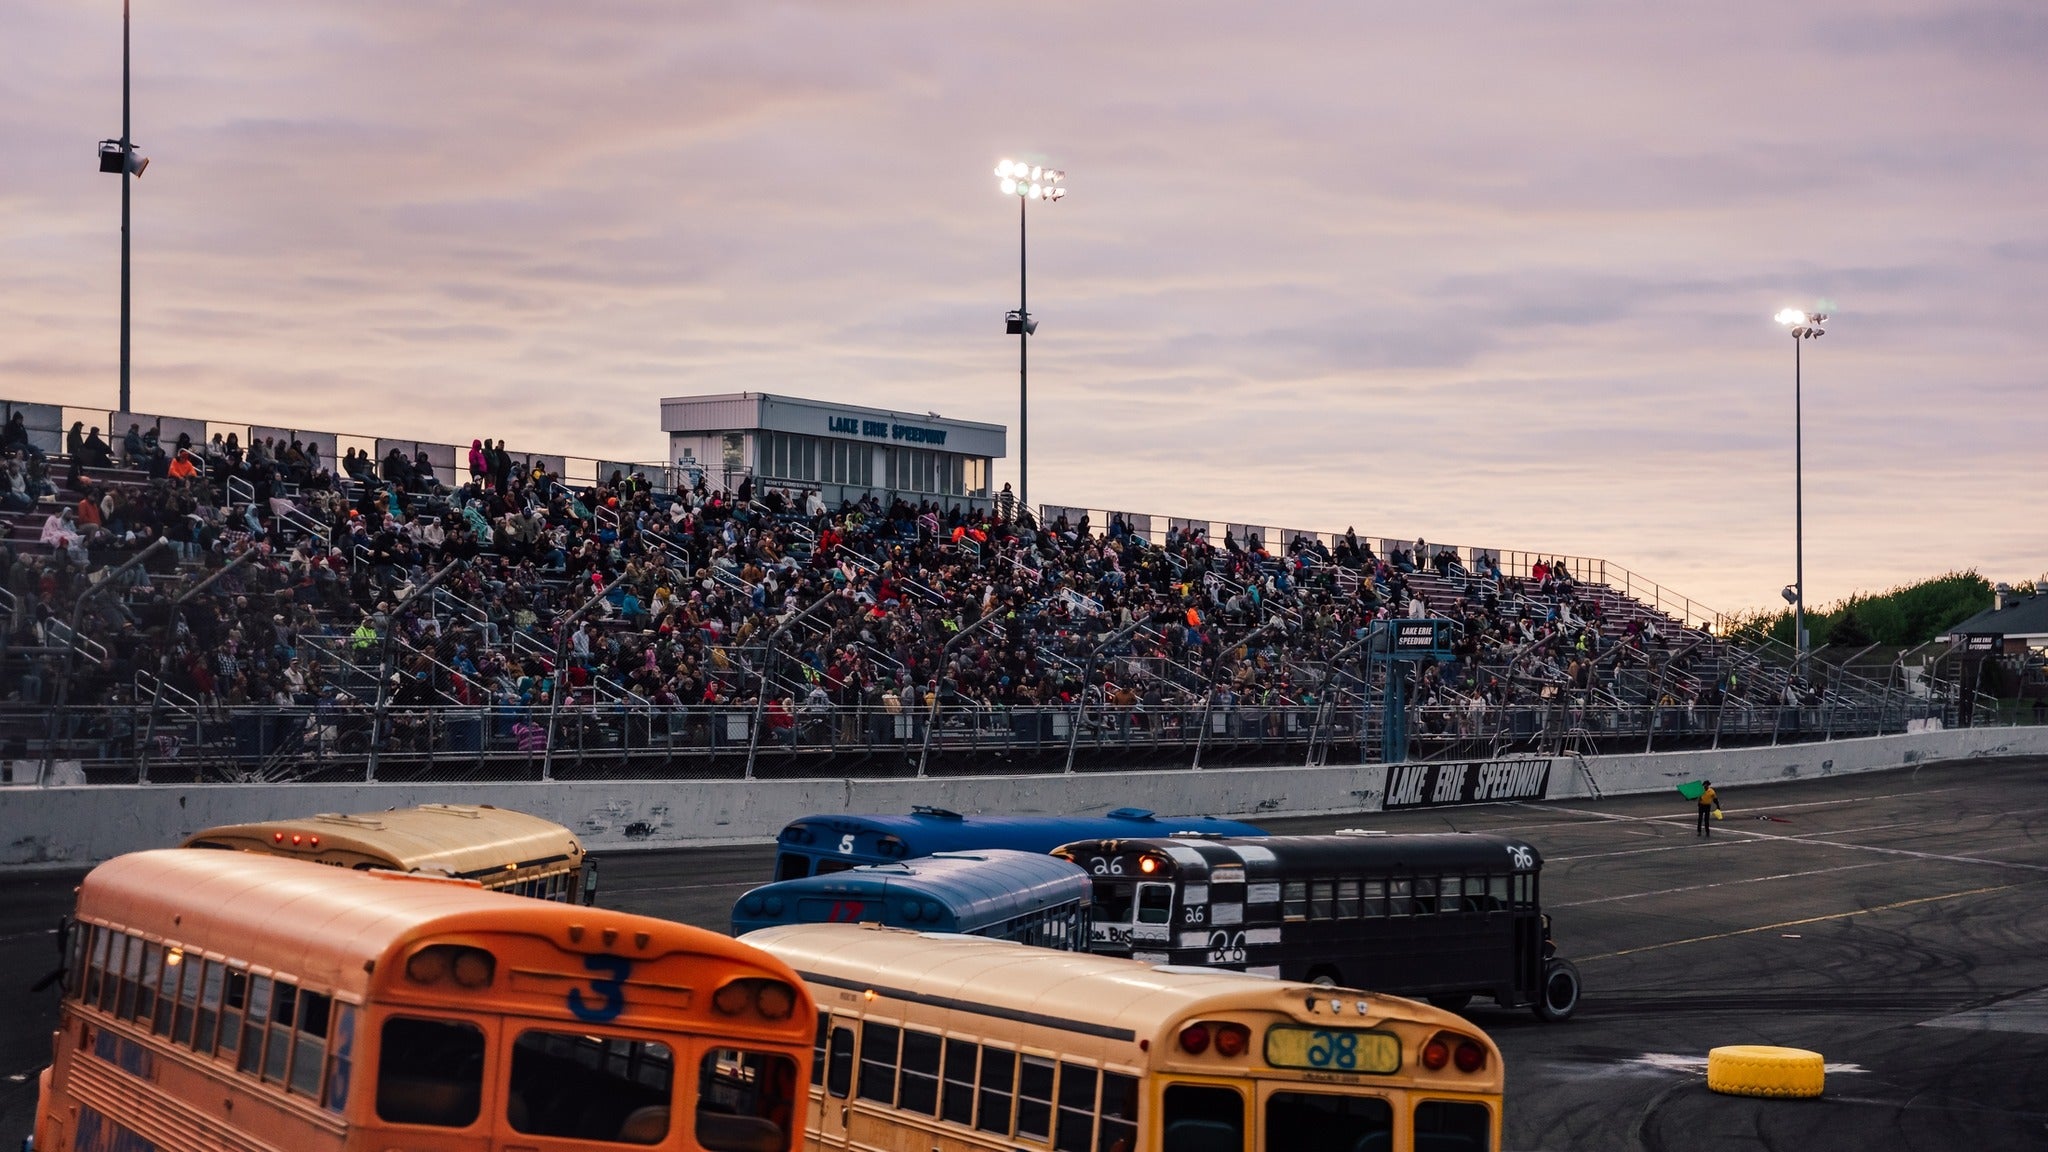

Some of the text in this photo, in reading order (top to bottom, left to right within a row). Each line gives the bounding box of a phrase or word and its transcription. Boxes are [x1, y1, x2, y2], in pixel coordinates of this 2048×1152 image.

[828, 415, 948, 446] LAKE ERIE SPEEDWAY
[1398, 637, 1433, 645] SPEEDWAY
[1402, 627, 1432, 635] LAKE ERIE
[1386, 759, 1549, 806] LAKE ERIE SPEEDWAY
[838, 834, 855, 855] 5
[1090, 855, 1124, 875] 26
[1185, 905, 1205, 923] 26
[1108, 926, 1134, 945] BUS
[1209, 930, 1246, 962] 26
[568, 955, 632, 1022] 3
[1308, 1030, 1358, 1069] 28
